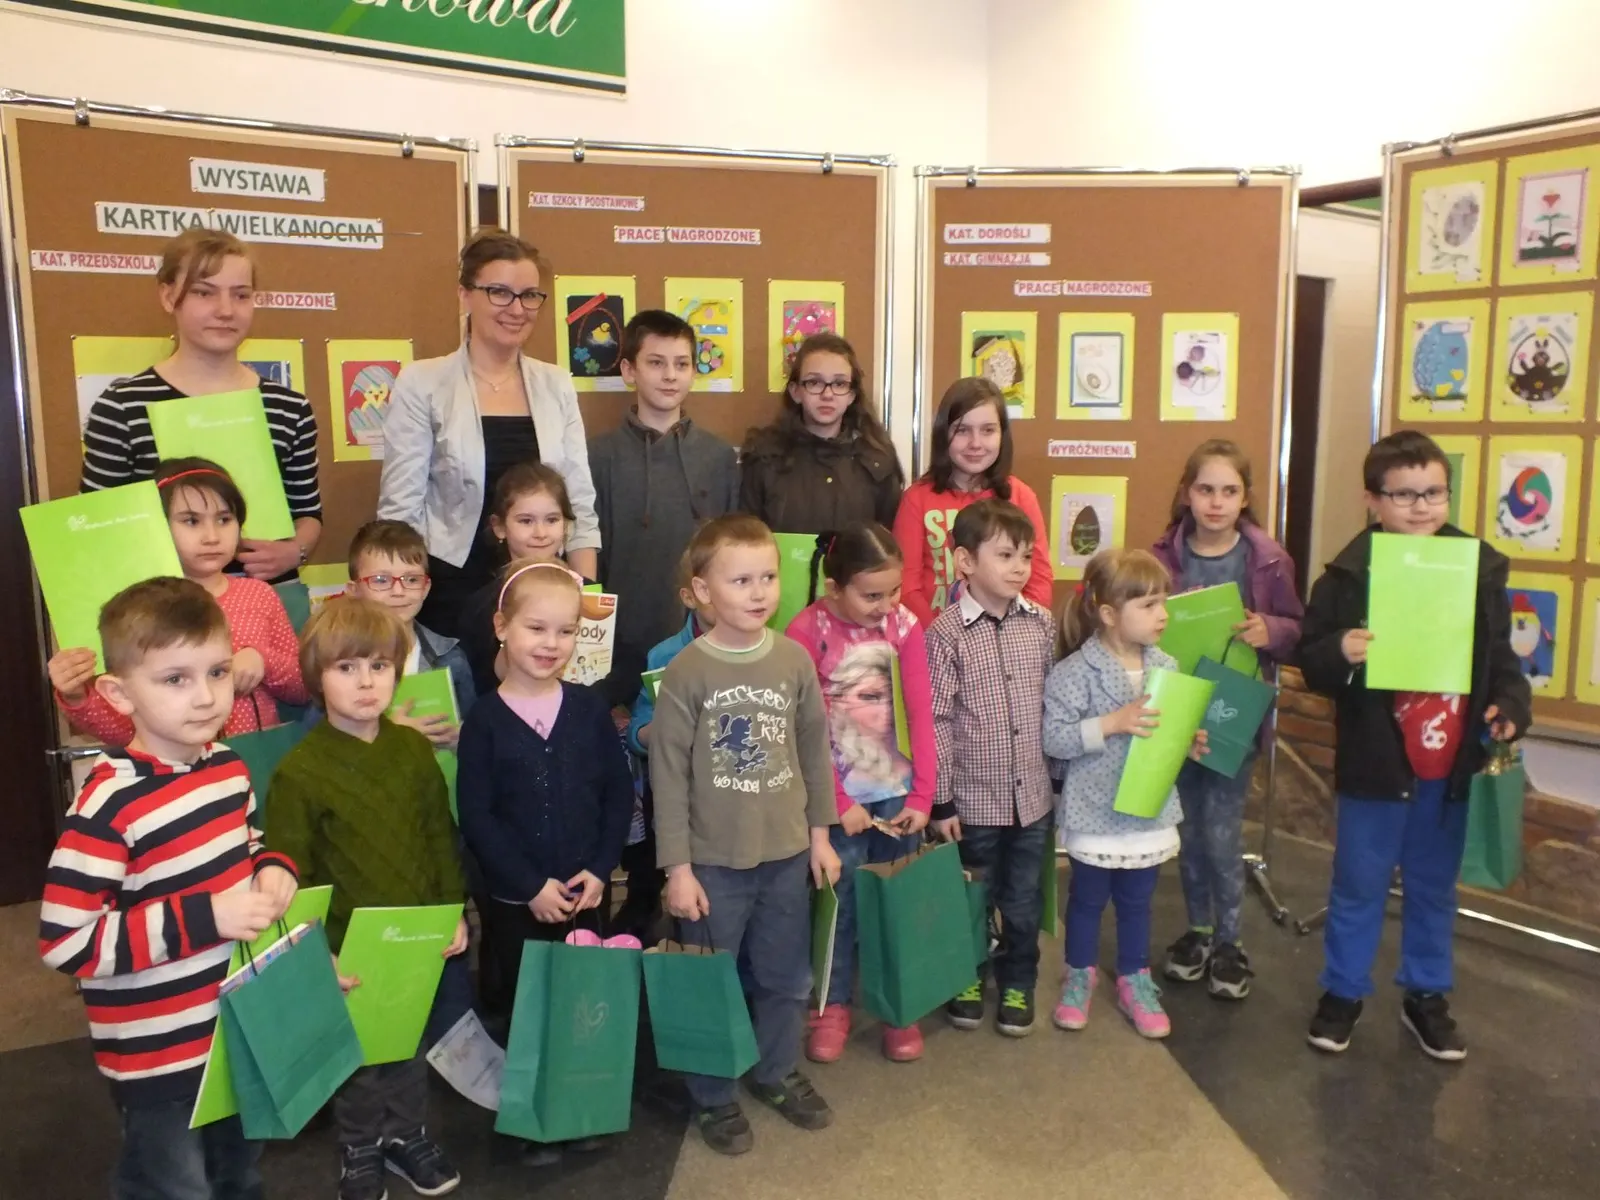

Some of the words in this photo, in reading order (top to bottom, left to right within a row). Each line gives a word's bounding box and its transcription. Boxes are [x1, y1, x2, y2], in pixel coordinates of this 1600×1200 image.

[198, 166, 312, 195] WYSTAWA
[533, 194, 549, 206] KAT.
[103, 206, 202, 231] KARTKA
[218, 213, 378, 243] WIELKANOCNA
[618, 228, 660, 241] PRACE
[671, 229, 757, 242] NAGRODZONE
[949, 229, 974, 240] KAT.
[979, 226, 1031, 239] DOROŚLI
[40, 252, 67, 267] KAT.
[70, 254, 157, 271] PRZEDSZKOLA
[976, 254, 1031, 266] GIMNAZJA
[1018, 282, 1058, 294] PRACE
[1068, 282, 1149, 294] NAGRODZONE
[254, 291, 333, 308] GRODZONE
[1051, 443, 1131, 456] WYRÓŻNIENIA
